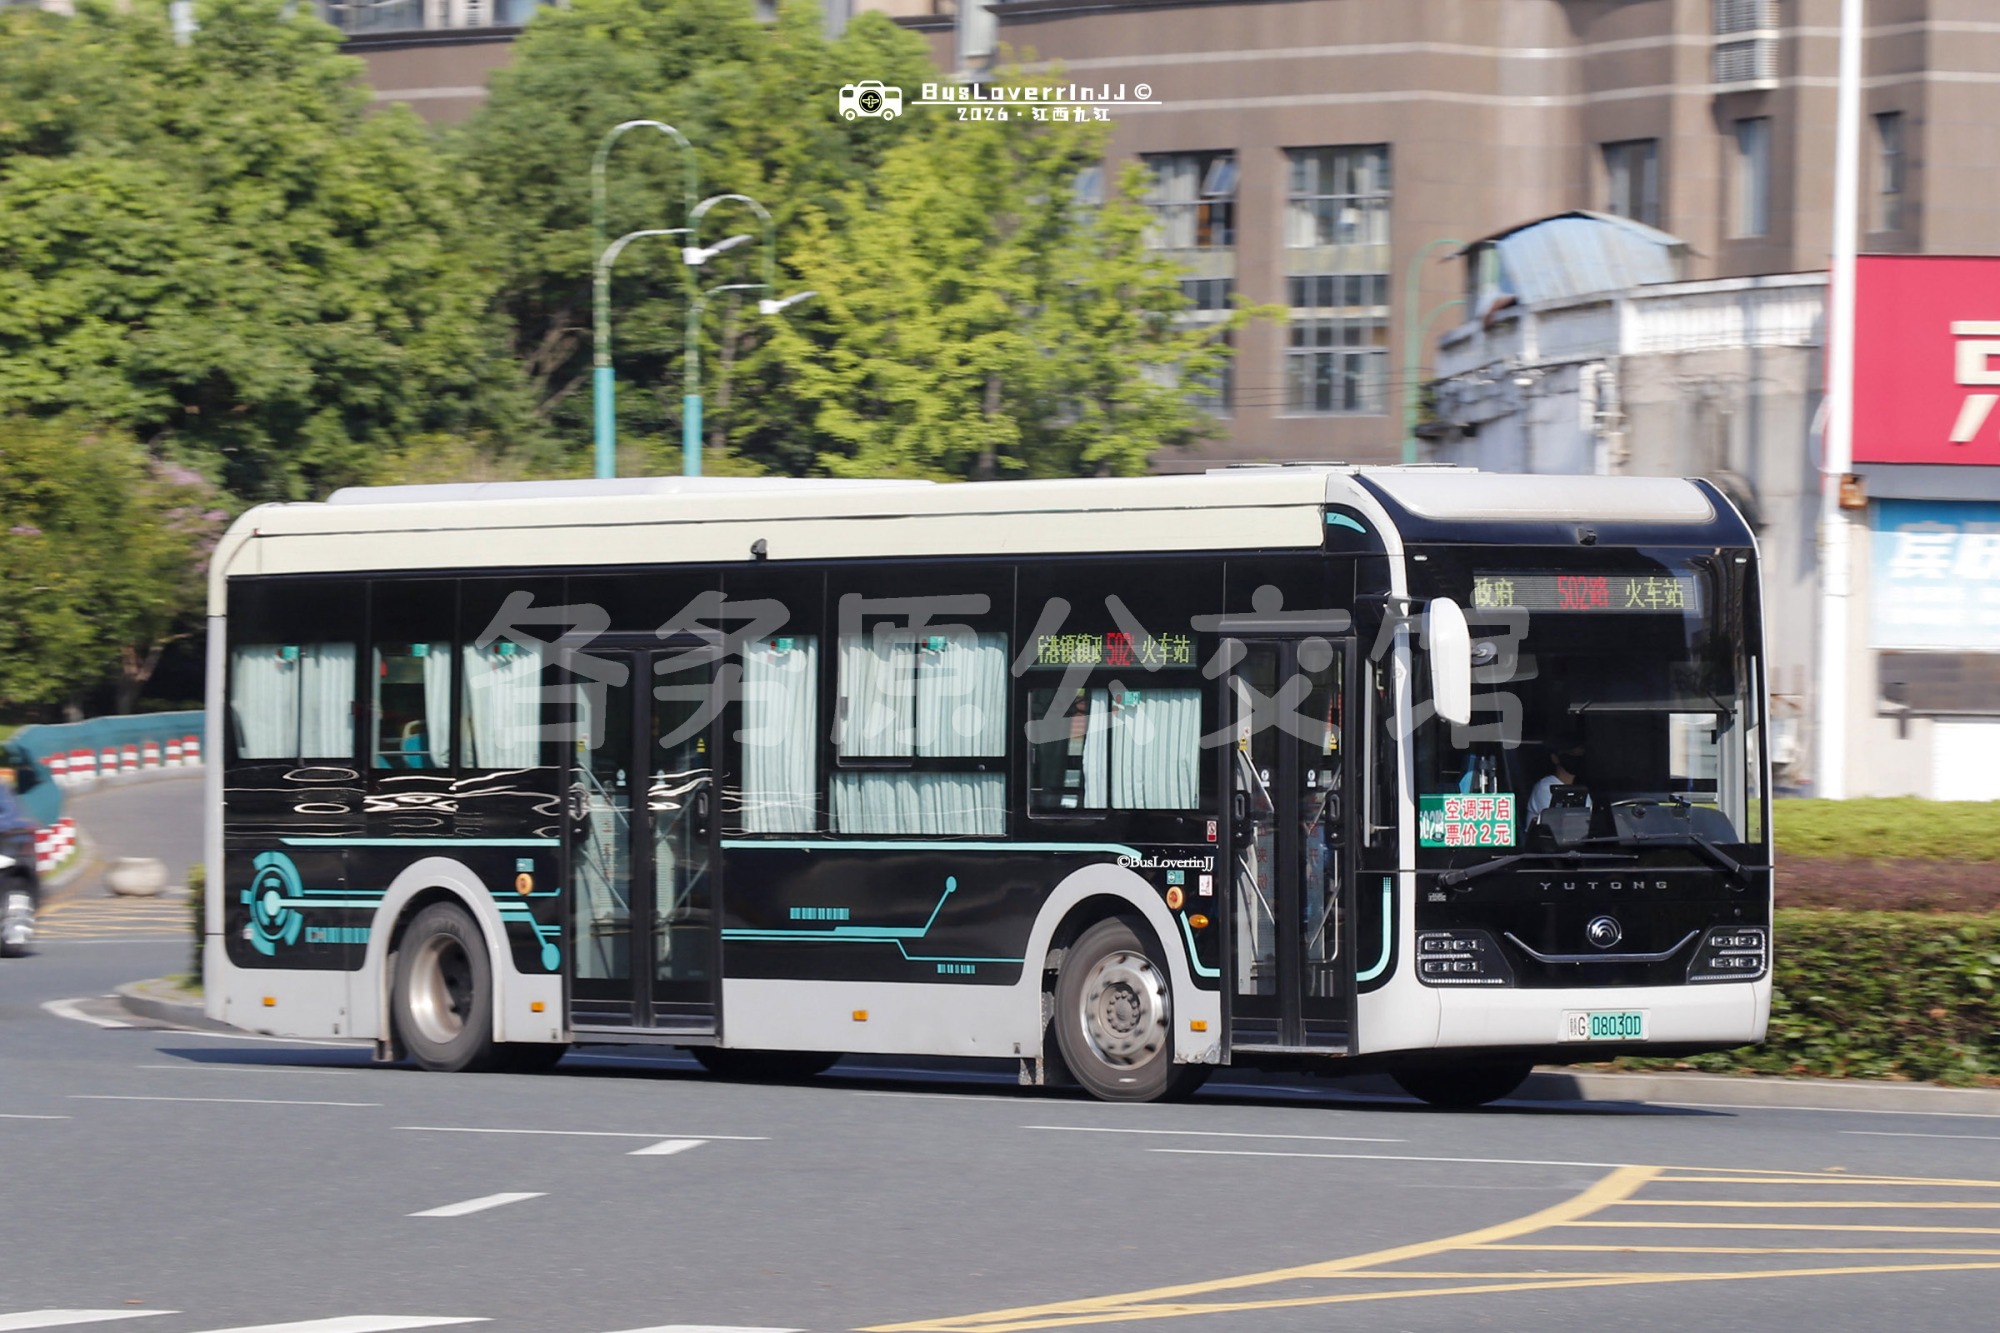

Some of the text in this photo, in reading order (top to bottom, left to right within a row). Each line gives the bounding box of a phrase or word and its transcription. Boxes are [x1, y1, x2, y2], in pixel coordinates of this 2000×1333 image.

[1474, 575, 1685, 610] 政府 502路 火车站
[1106, 632, 1135, 667] 502
[1141, 632, 1191, 666] 火车站
[1444, 797, 1511, 821] 空调开启
[1444, 822, 1511, 846] 票价2元
[1539, 880, 1669, 891] YUTONG
